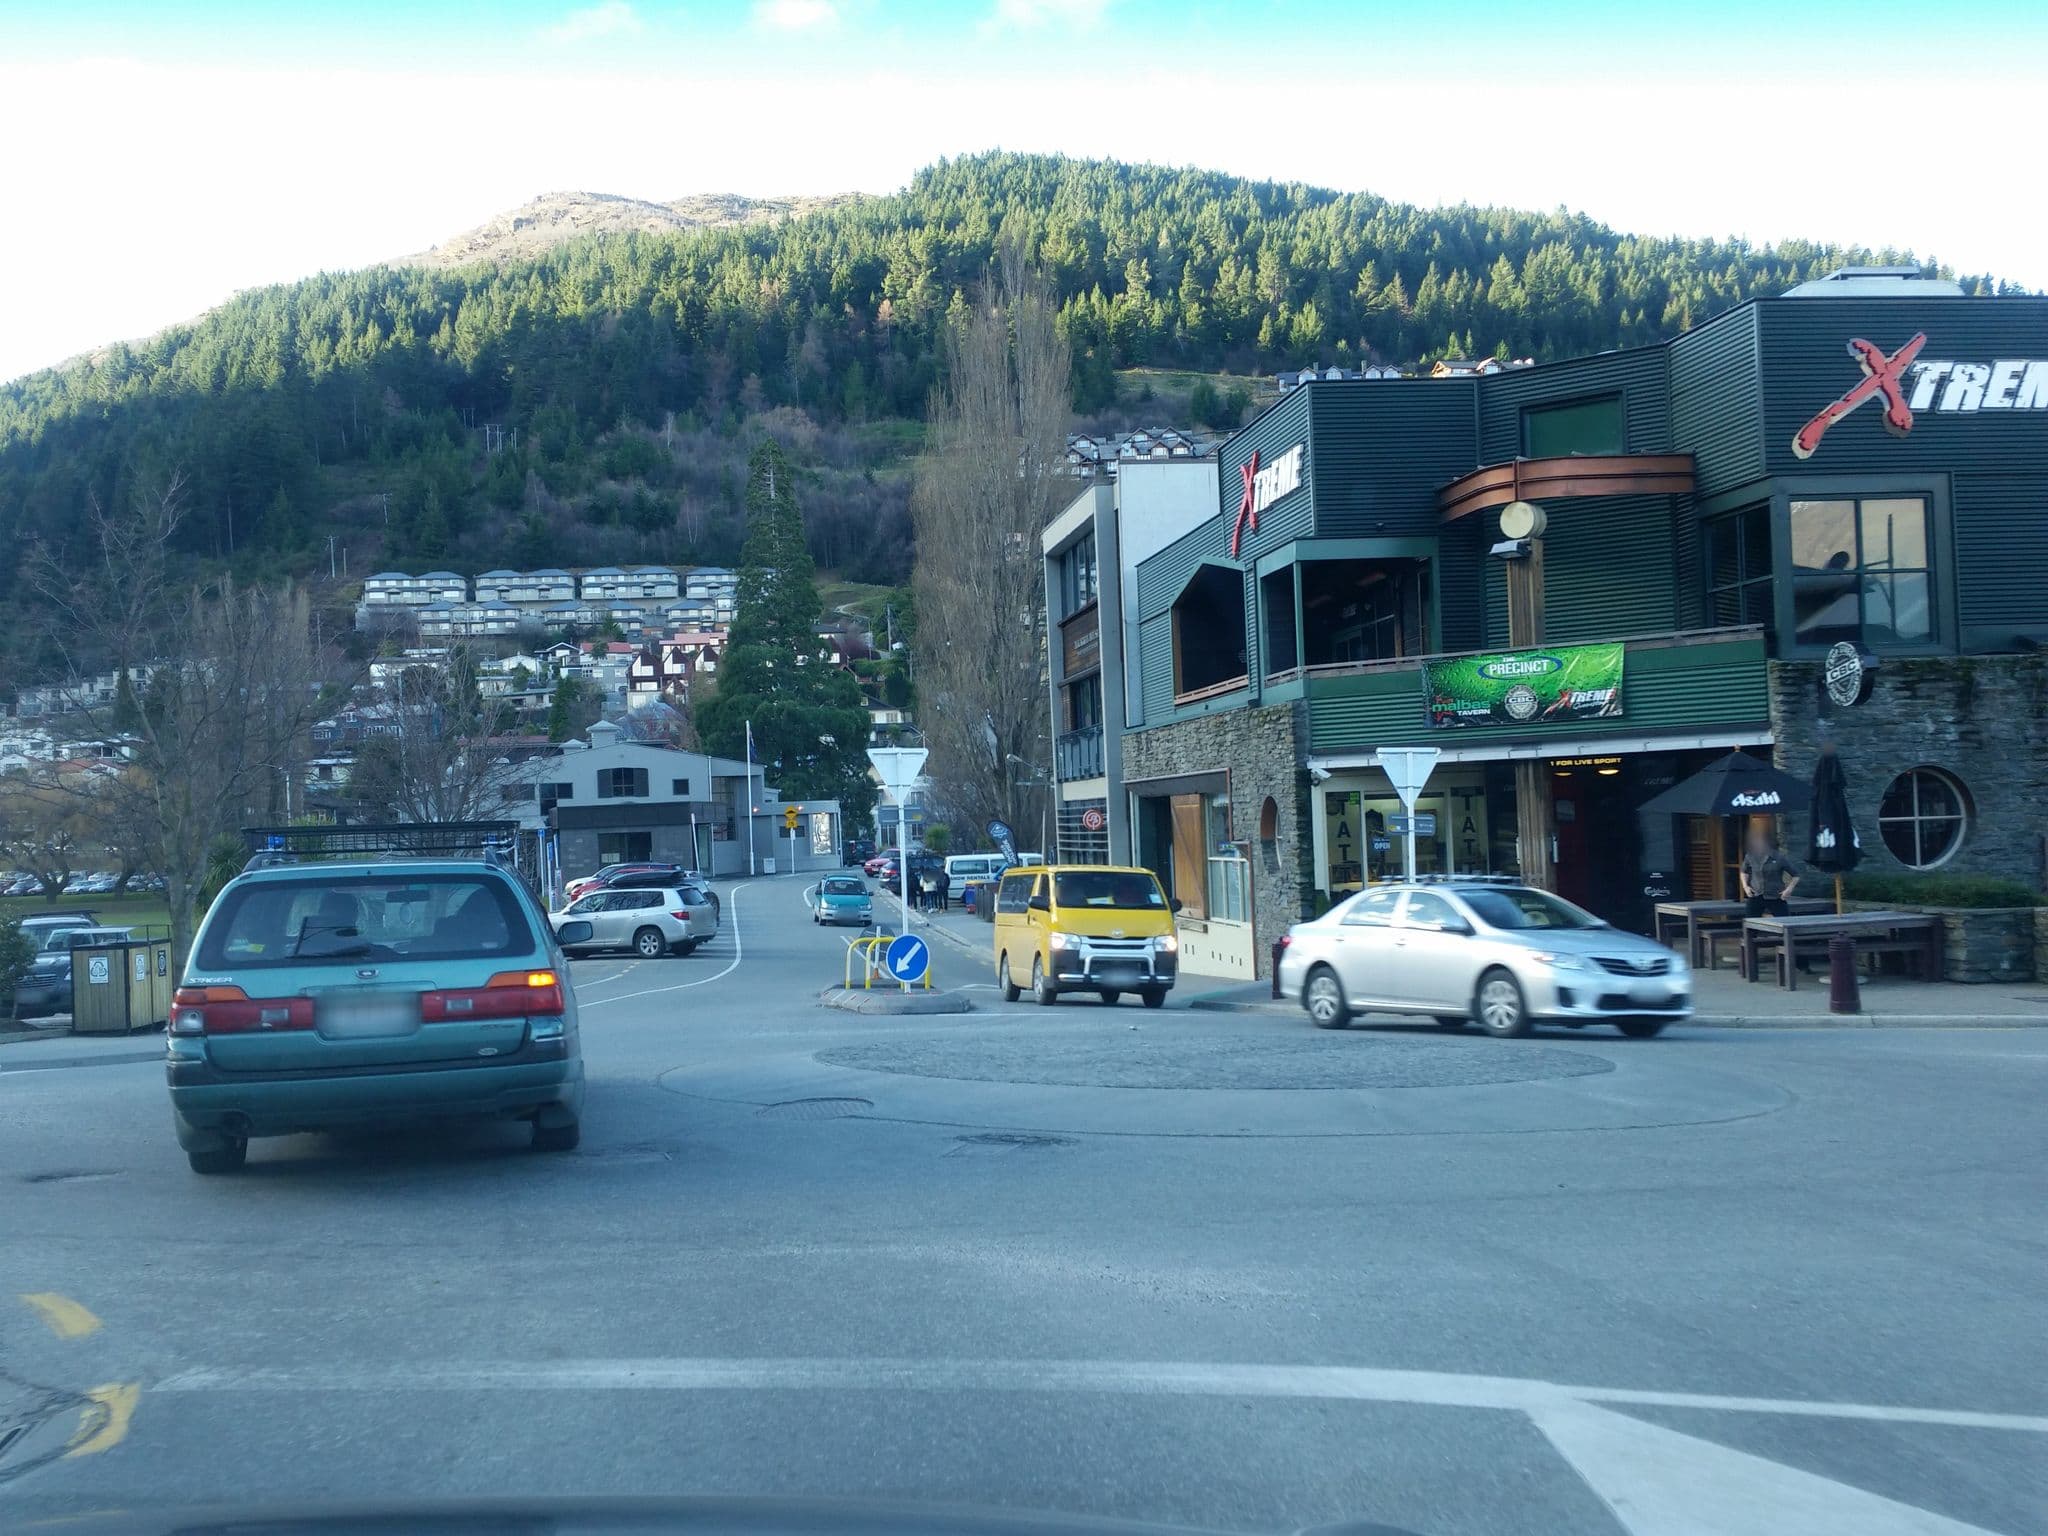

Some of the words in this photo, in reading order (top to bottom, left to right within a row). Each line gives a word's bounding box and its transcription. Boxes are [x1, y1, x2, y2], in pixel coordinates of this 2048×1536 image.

[1231, 444, 1305, 560] XTREME
[1488, 659, 1550, 675] PRECINCT
[1830, 661, 1857, 680] CBC
[1508, 696, 1534, 704] CBC
[1456, 708, 1491, 717] TAVERN
[1556, 759, 1573, 767] FOR
[1574, 758, 1592, 766] LIVE
[1593, 757, 1622, 765] SPORT
[1731, 790, 1781, 807] Asahi
[1374, 842, 1391, 850] OPEN
